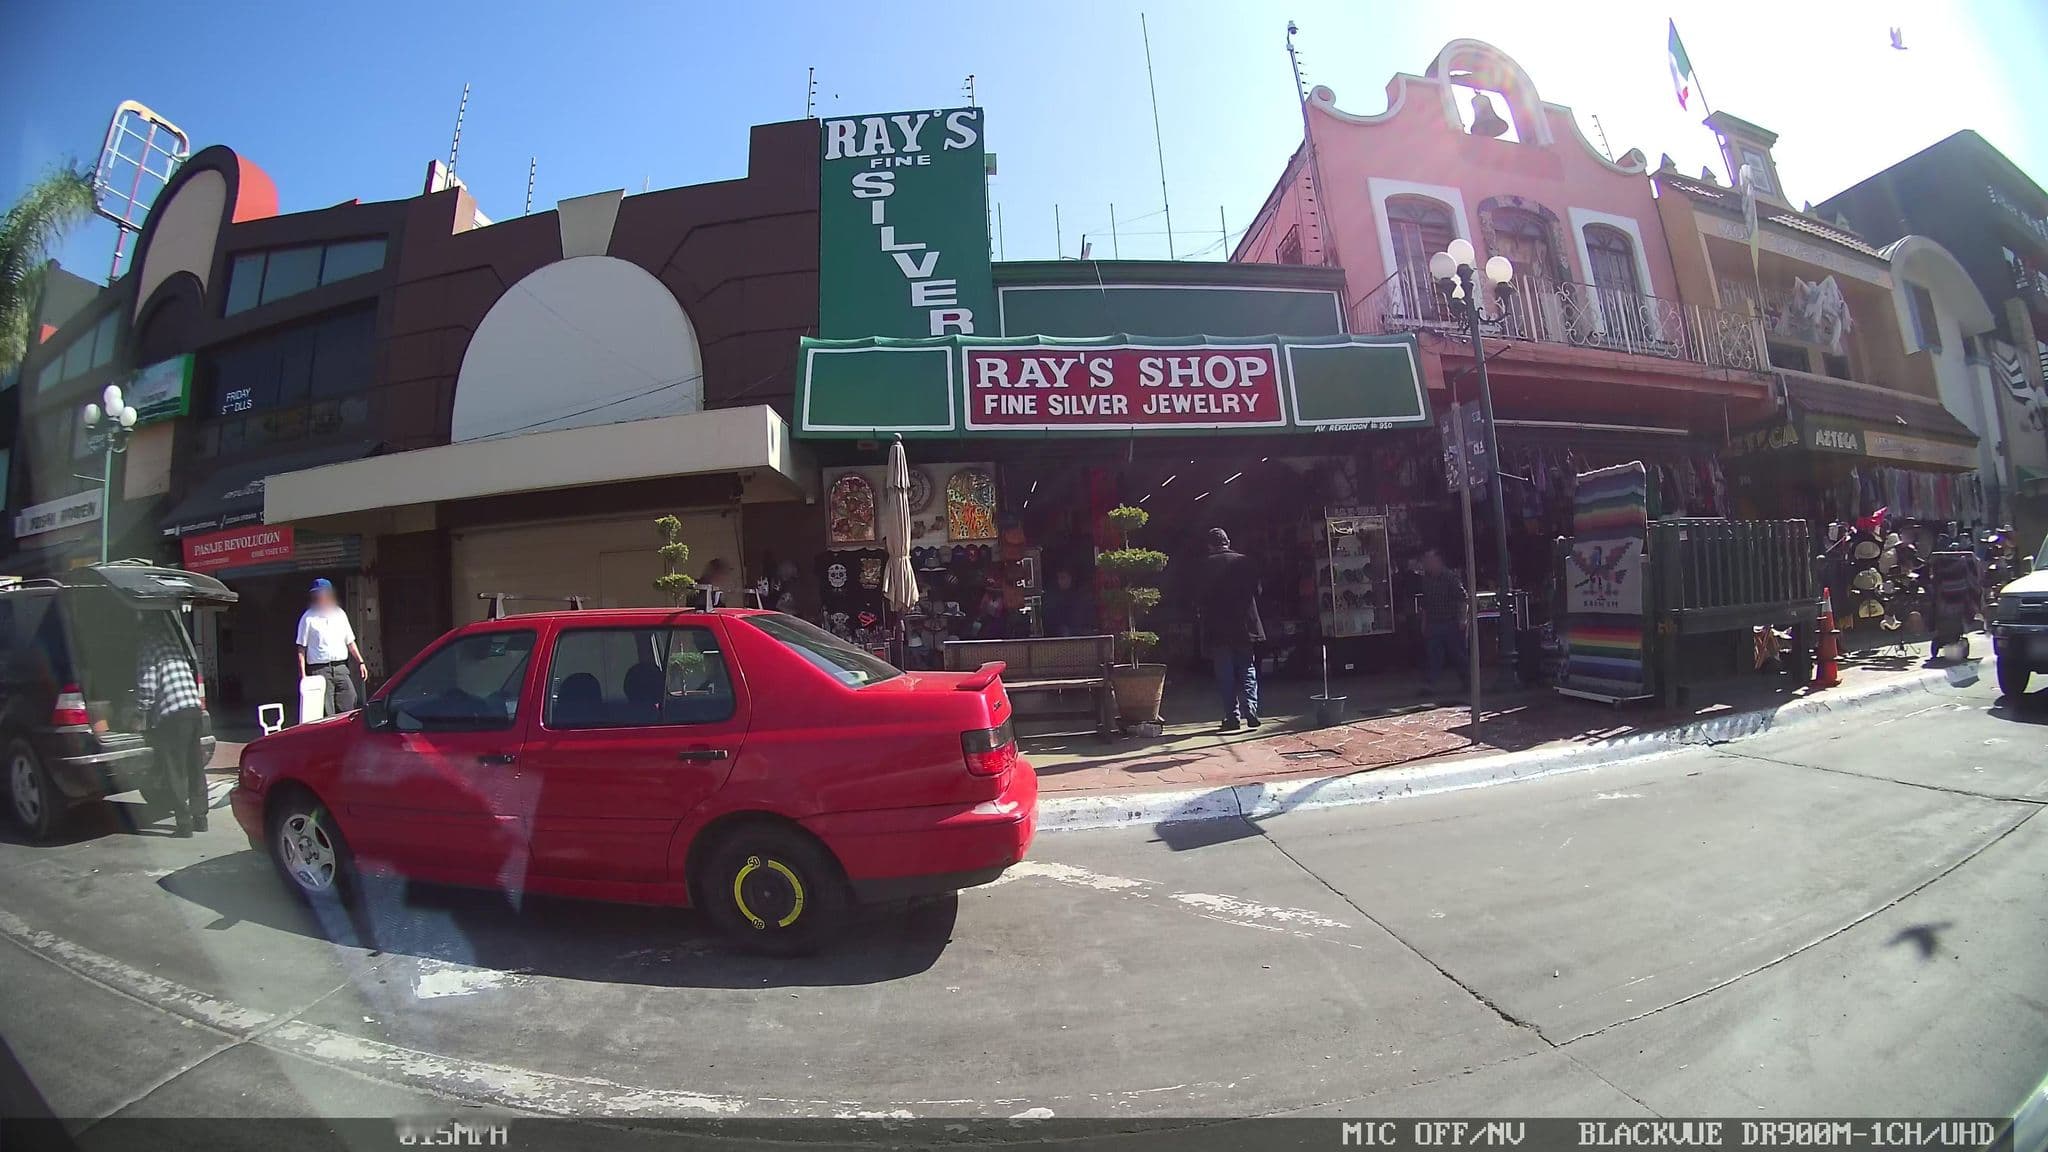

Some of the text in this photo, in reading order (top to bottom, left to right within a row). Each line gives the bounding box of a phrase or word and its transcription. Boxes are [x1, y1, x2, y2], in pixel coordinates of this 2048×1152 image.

[825, 110, 977, 160] RAY'S
[870, 154, 931, 169] FINE
[851, 171, 975, 336] SILVER
[975, 352, 1268, 388] RAY'S SHOP
[226, 387, 252, 402] FRIDAY
[984, 393, 1260, 415] FINE SILVER JEWELRY
[194, 531, 280, 557] PASAJE REVOLUCION
